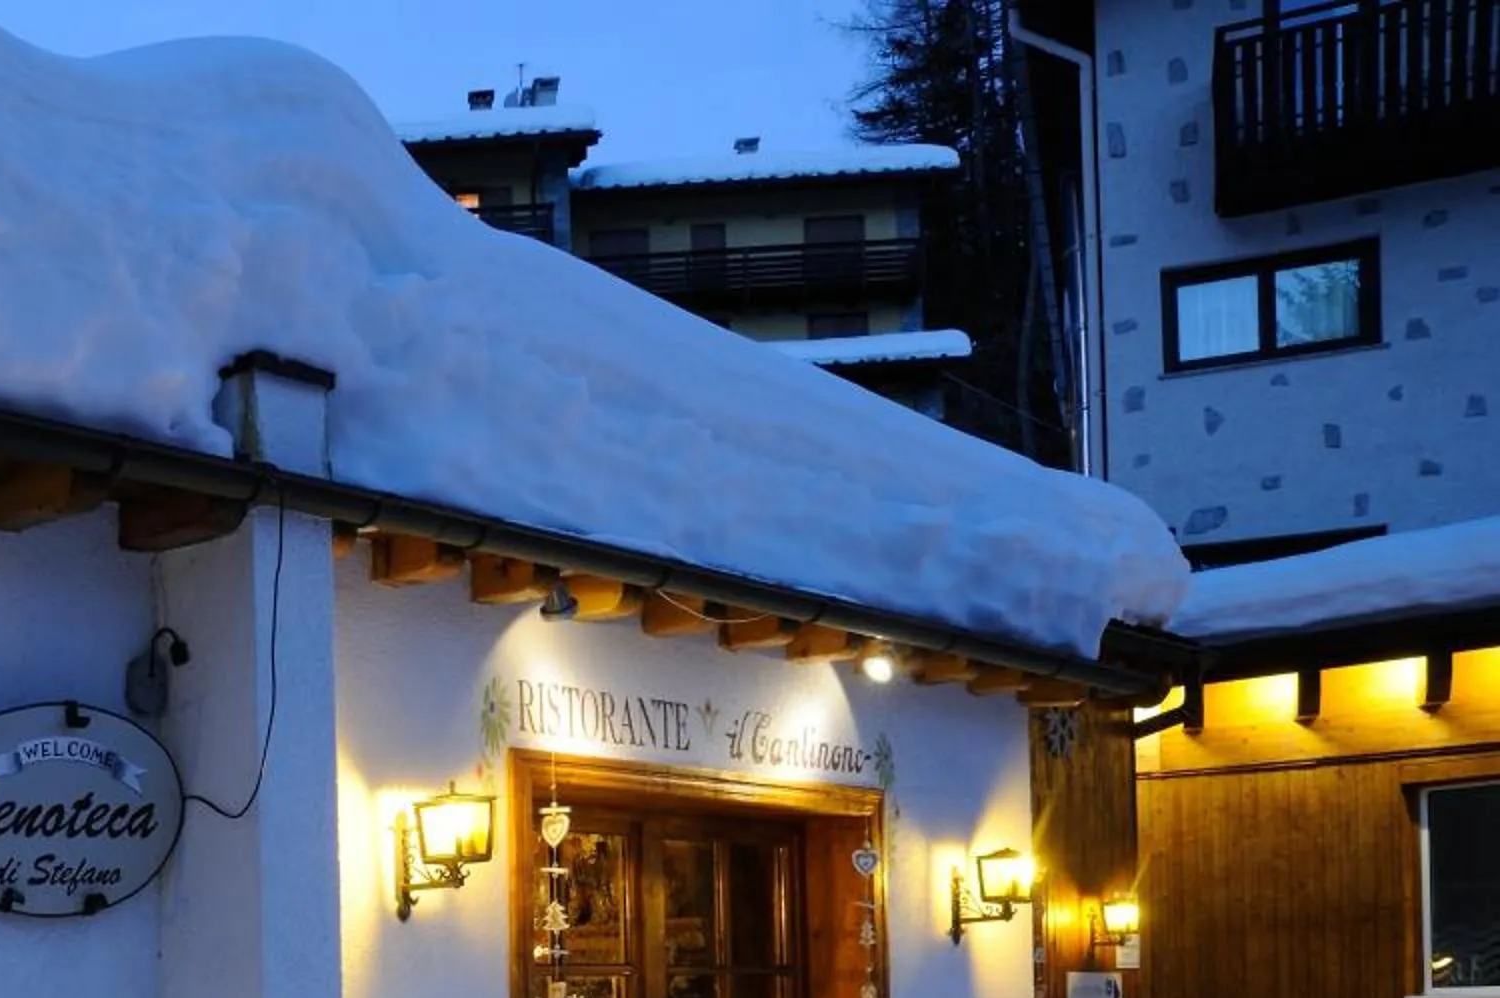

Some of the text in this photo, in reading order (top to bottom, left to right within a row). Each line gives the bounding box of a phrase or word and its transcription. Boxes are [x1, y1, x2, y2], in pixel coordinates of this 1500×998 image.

[516, 679, 691, 752] RISTORANTE
[22, 740, 115, 768] WELCOME
[28, 853, 123, 896] Stefano
